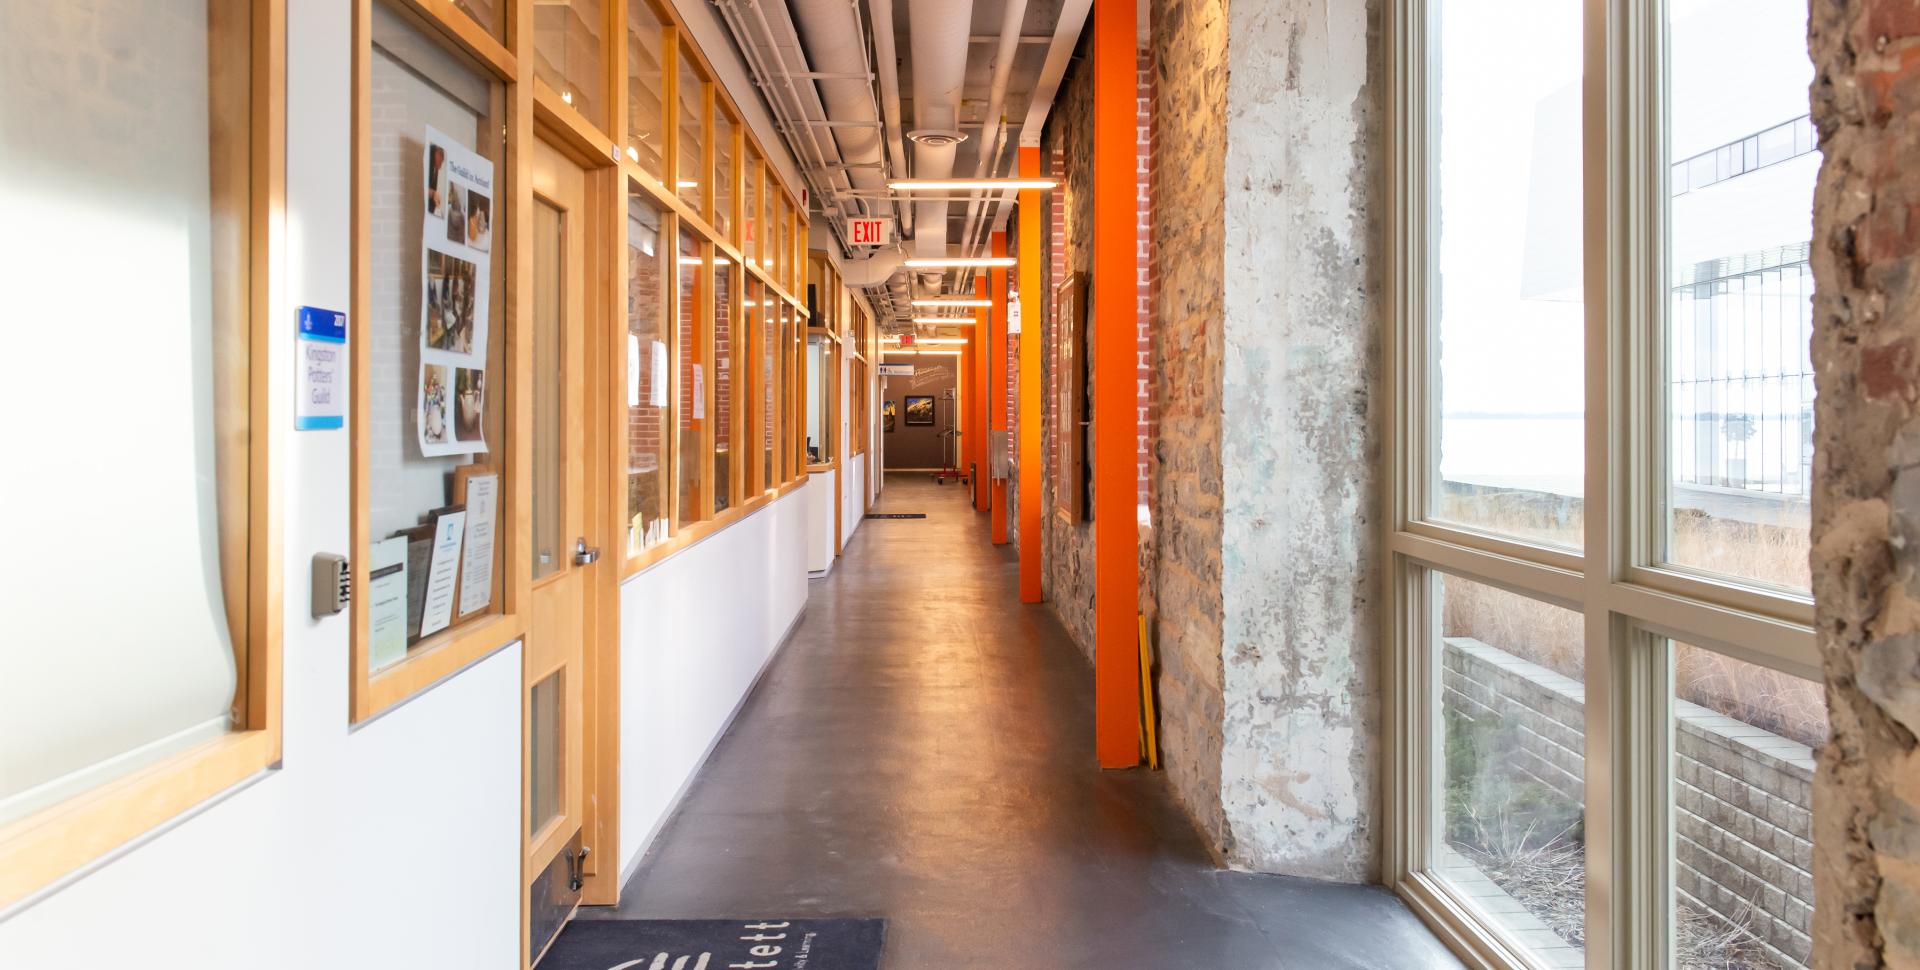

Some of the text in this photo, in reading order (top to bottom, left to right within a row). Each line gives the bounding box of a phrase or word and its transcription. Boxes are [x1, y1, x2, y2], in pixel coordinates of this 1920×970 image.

[854, 221, 882, 243] EXIT
[306, 345, 336, 366] Kingston
[311, 387, 331, 405] Guild
[729, 921, 790, 969] tett
